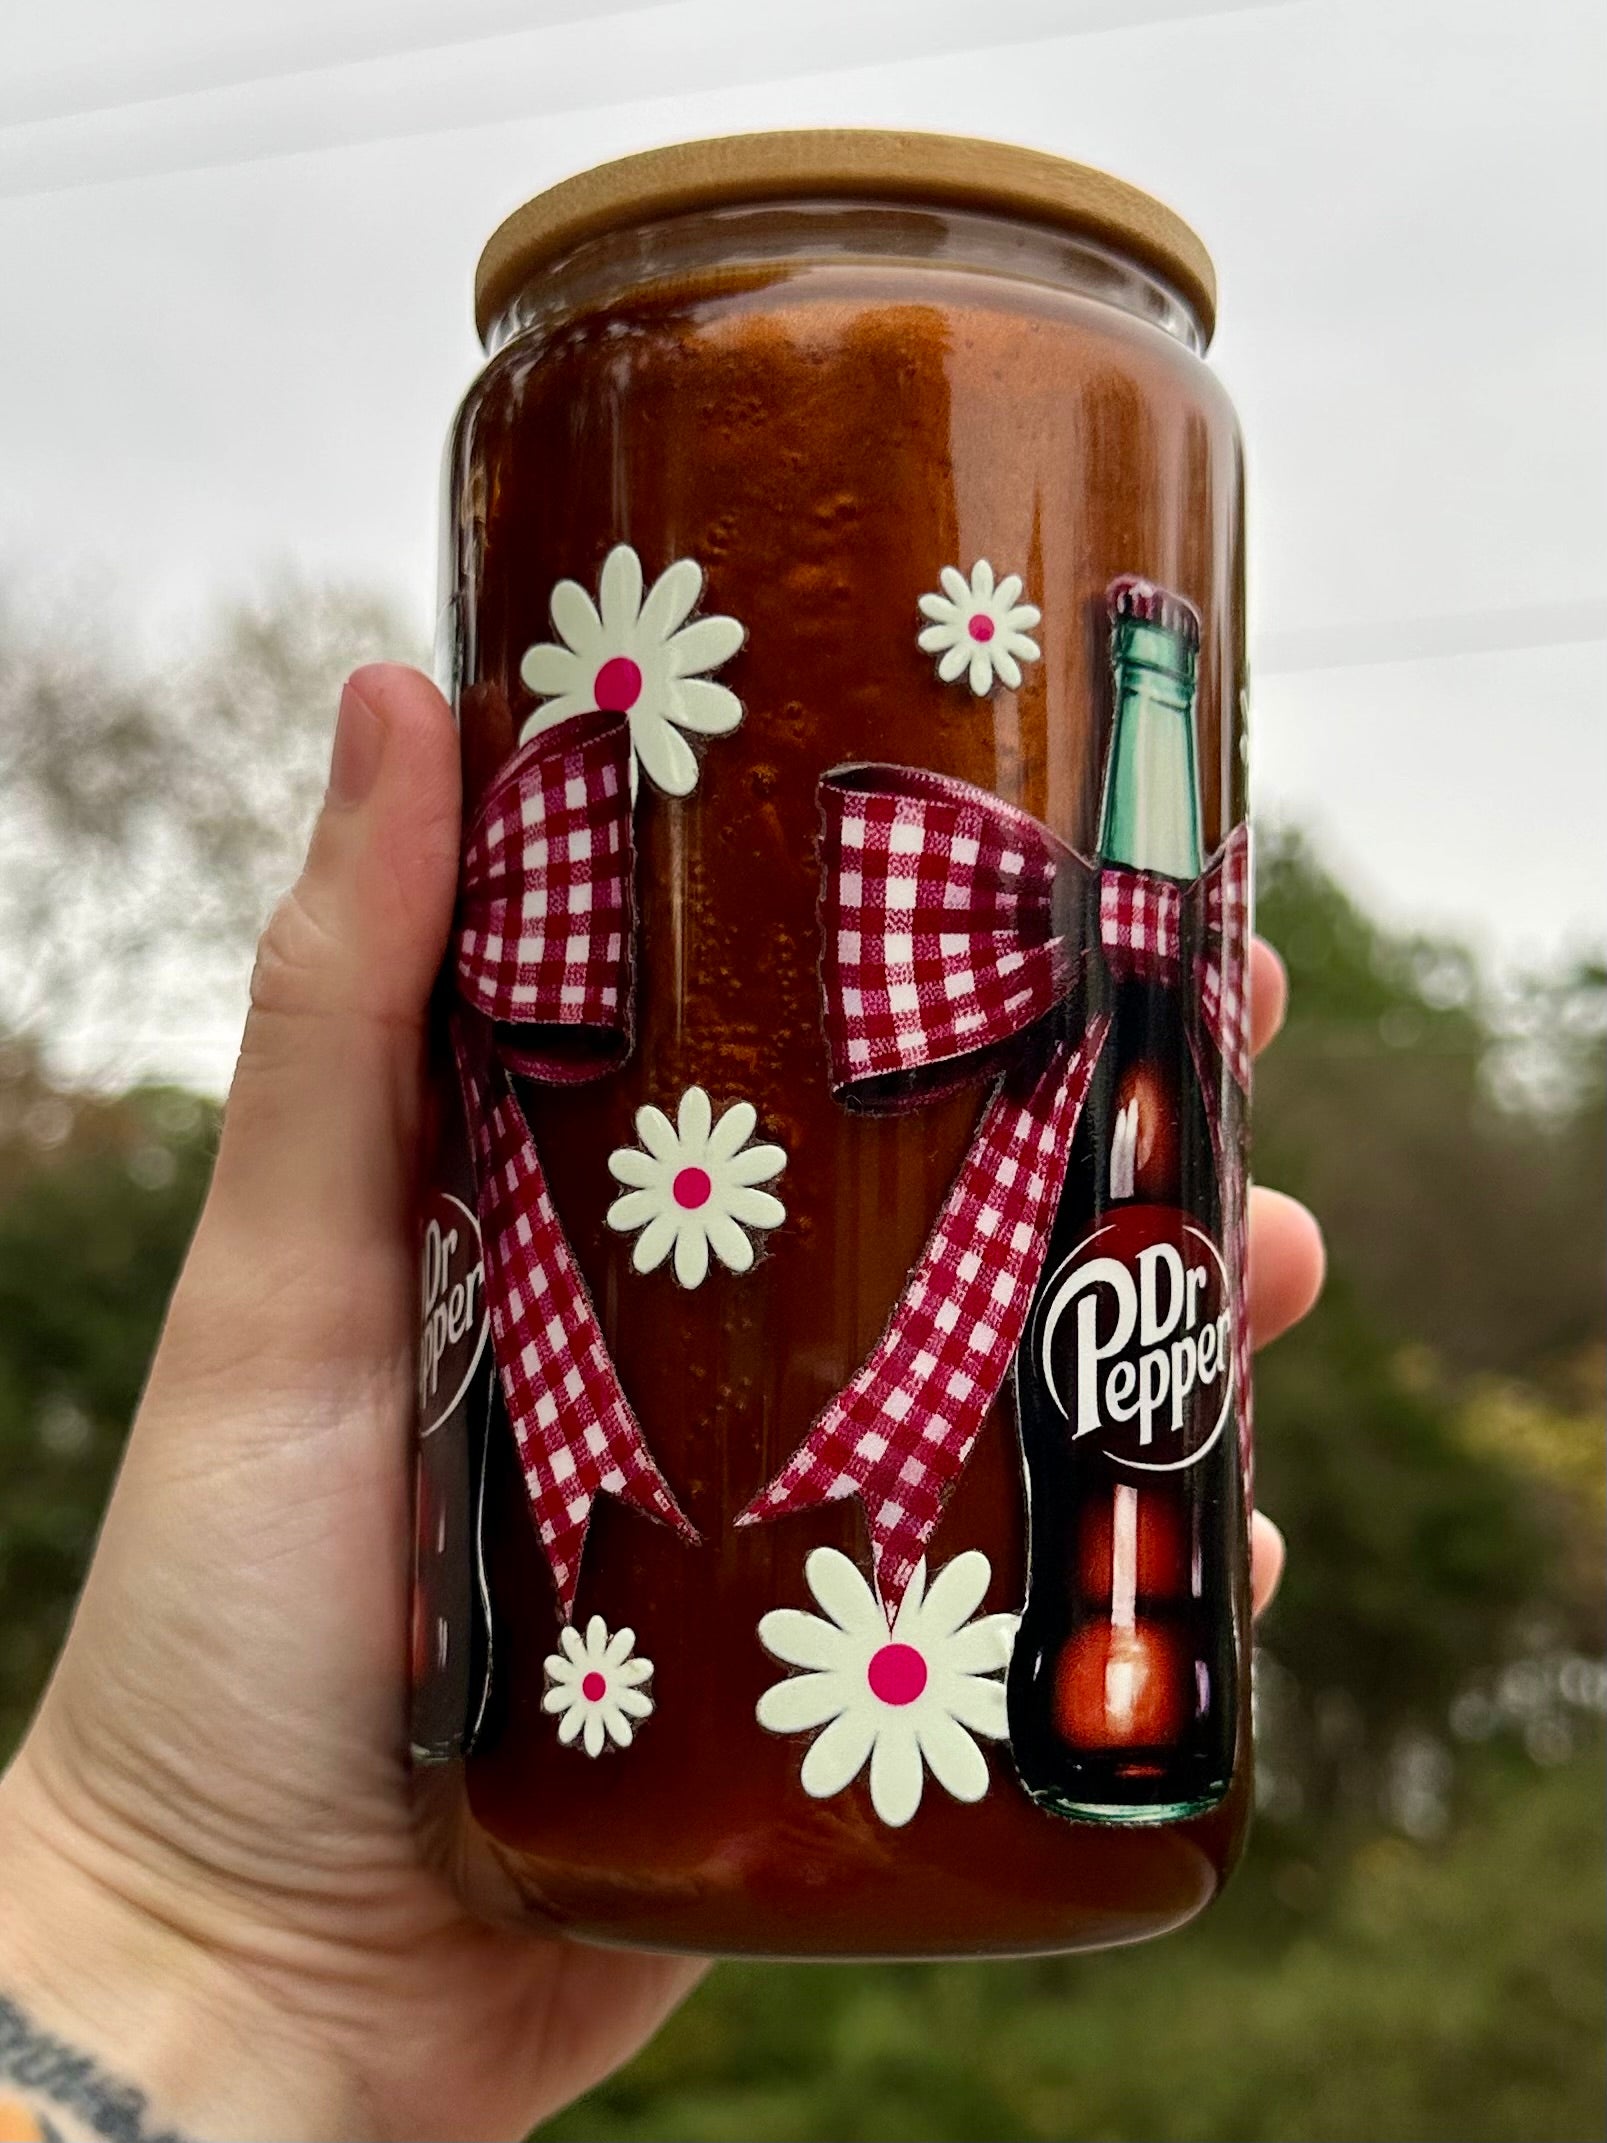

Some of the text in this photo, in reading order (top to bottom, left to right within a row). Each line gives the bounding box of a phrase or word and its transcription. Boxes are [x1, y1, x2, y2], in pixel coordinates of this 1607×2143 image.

[420, 1260, 486, 1410] pper
[1042, 1256, 1232, 1446] Pepper
[1135, 1242, 1207, 1347] Dr
